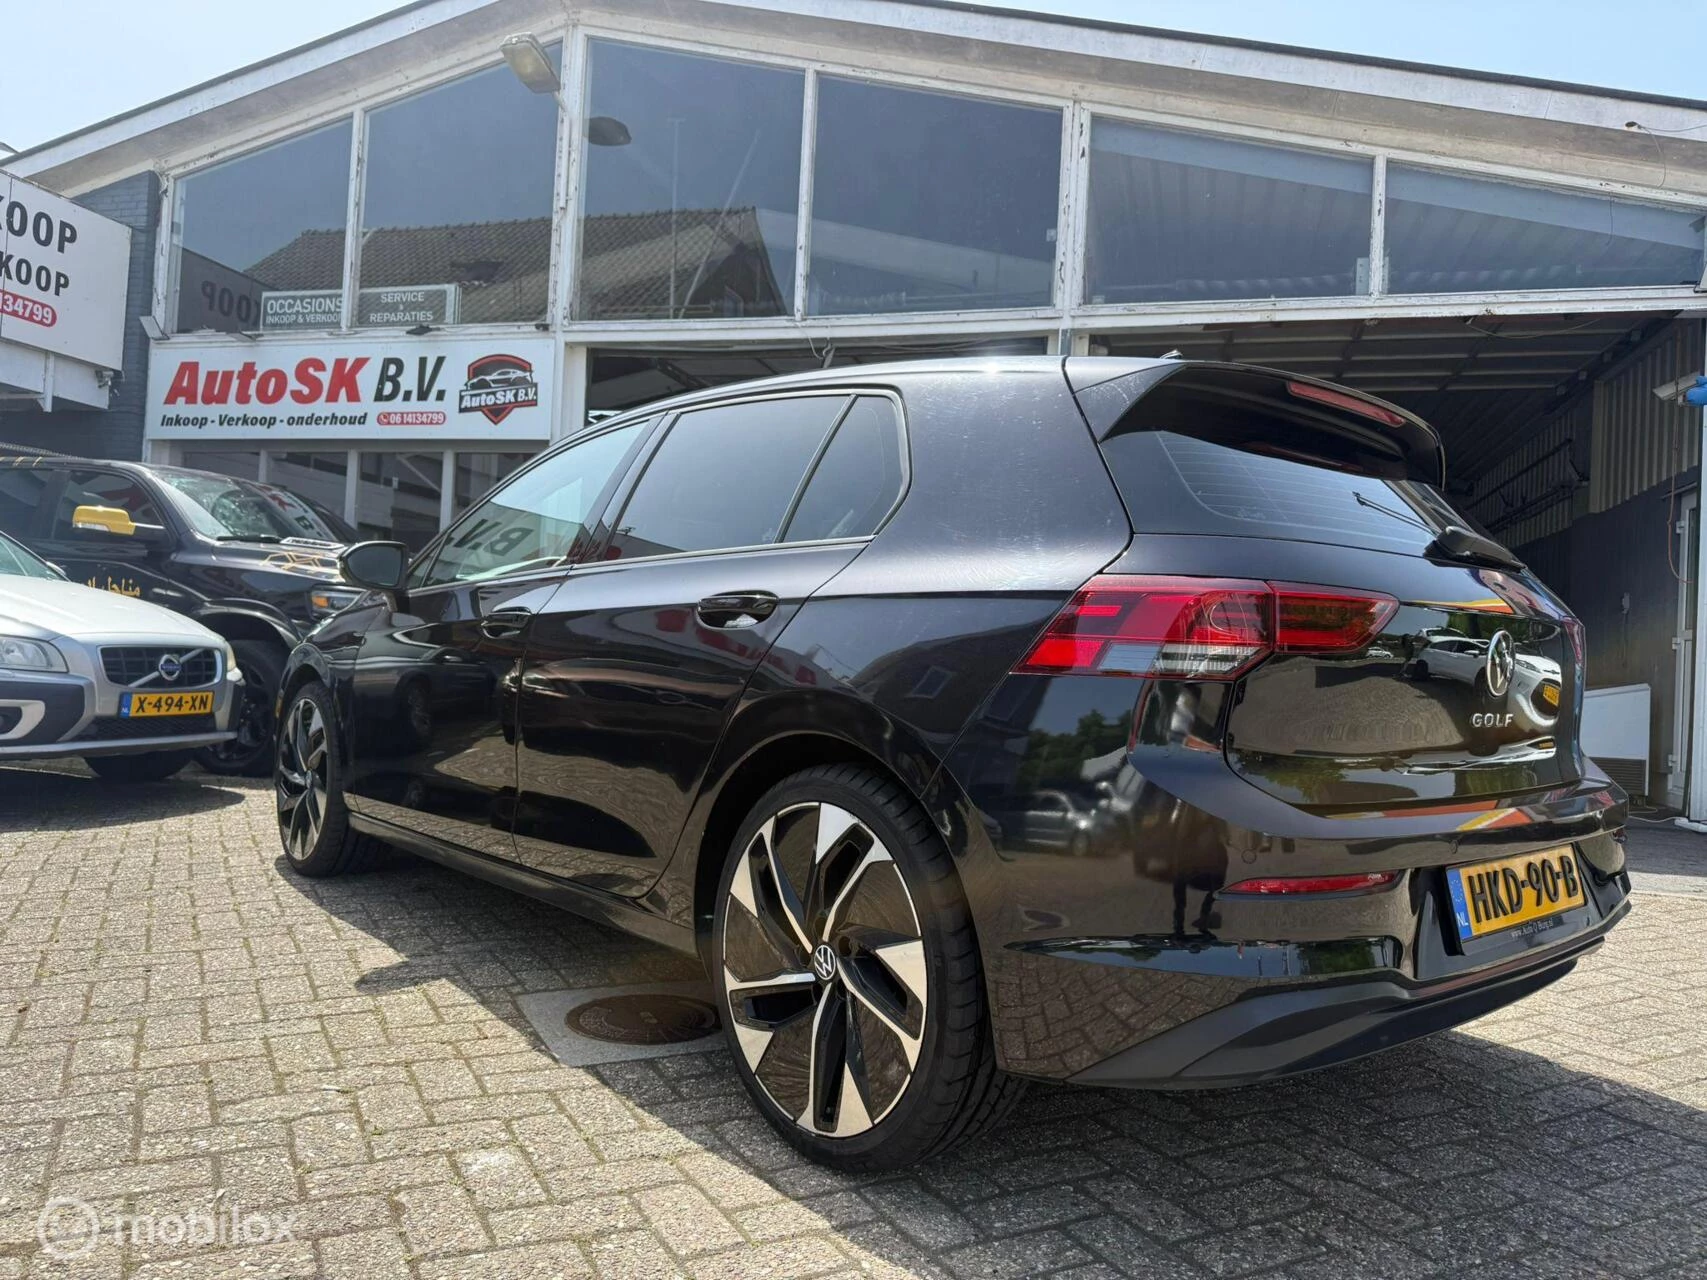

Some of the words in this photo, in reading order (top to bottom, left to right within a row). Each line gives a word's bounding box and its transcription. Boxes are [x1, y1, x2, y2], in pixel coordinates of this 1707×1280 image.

[0, 195, 78, 254] OOP
[381, 292, 425, 303] SERVICE
[266, 315, 296, 324] INKOOP
[369, 311, 434, 323] REPARATIES
[164, 357, 371, 406] AutoSK
[374, 356, 447, 402] B.V.
[461, 389, 516, 409] AutoSK
[518, 387, 537, 401] B.V.
[161, 414, 208, 429] Inkoop
[218, 413, 277, 429] Verkoop
[287, 412, 368, 426] onderhoud
[390, 414, 401, 424] 06
[403, 413, 444, 424] 14134799
[136, 695, 209, 713] X-494-XN
[1472, 713, 1514, 728] GOLF
[1468, 856, 1579, 924] HKD-90-B
[1456, 911, 1469, 927] NL
